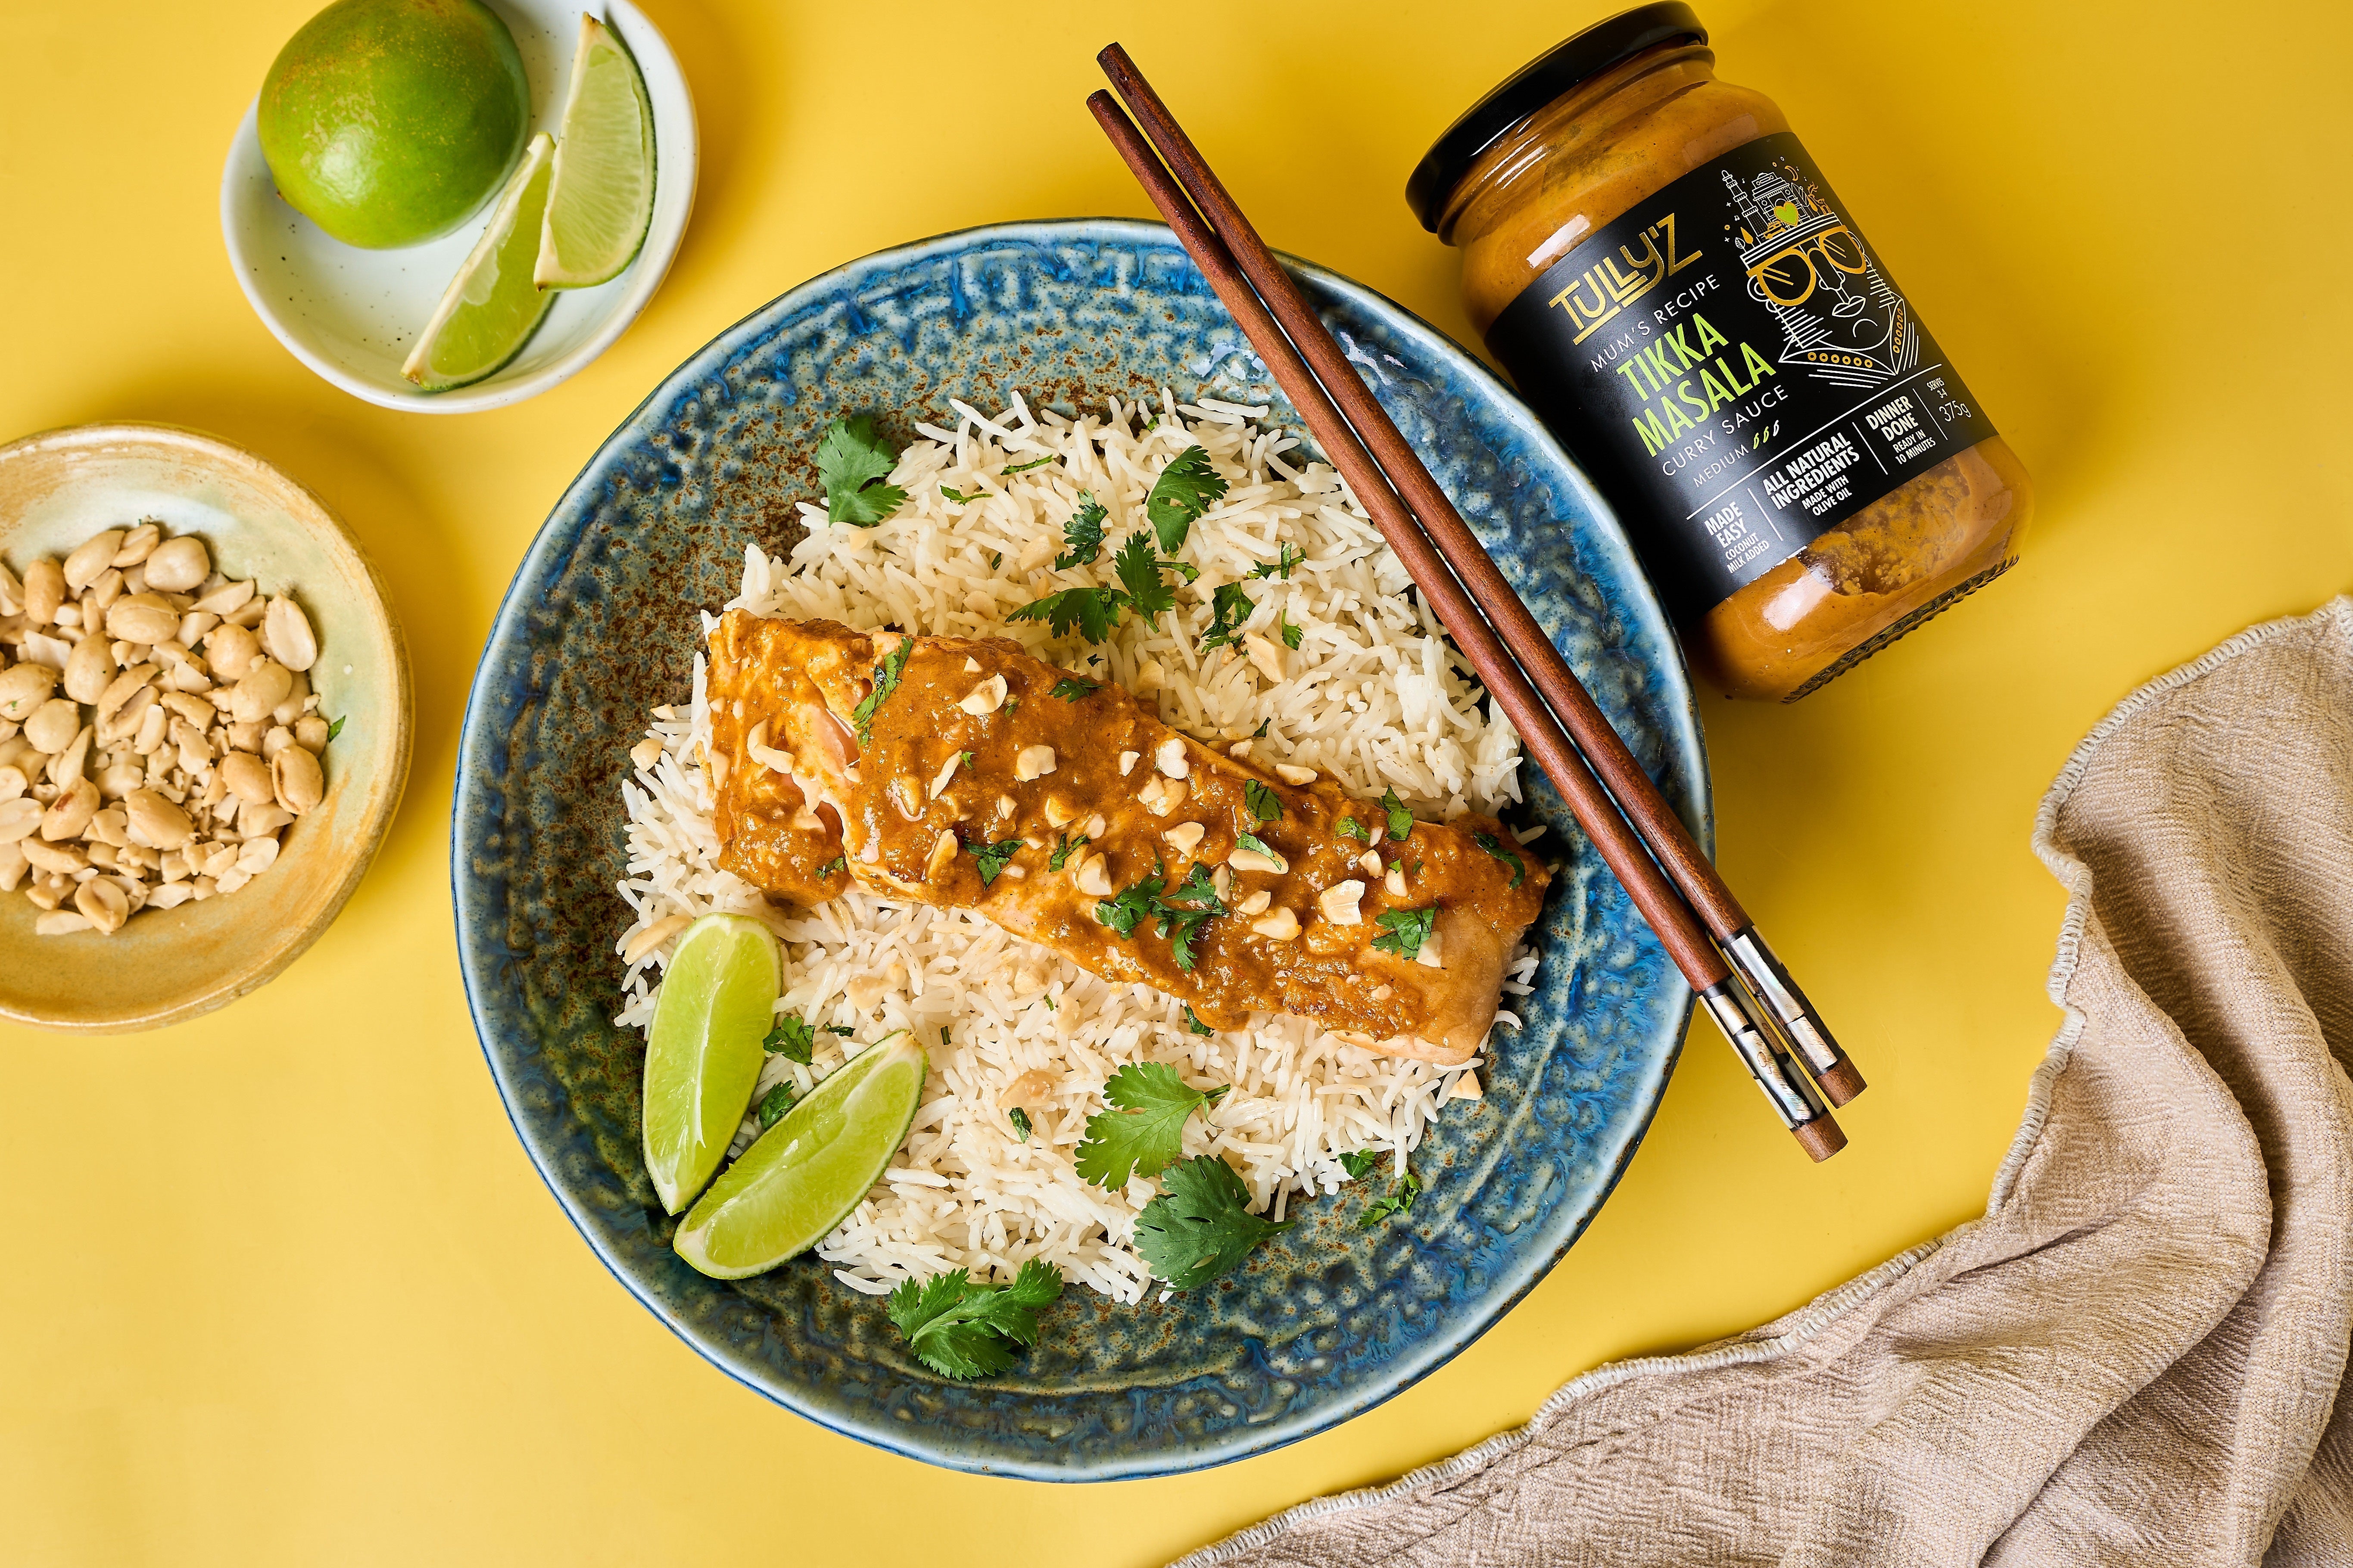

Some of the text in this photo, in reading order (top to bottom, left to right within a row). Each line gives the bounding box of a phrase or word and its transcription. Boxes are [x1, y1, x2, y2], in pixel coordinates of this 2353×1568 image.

[1590, 274, 1720, 373] MUM'S RECIPE
[1616, 313, 1729, 401] TIKKA
[1632, 342, 1776, 457] MASALA
[1926, 377, 1945, 391] SERVES
[1865, 396, 1914, 430] DINNER
[1881, 412, 1918, 442] DONE
[1939, 400, 1971, 422] 375g
[1662, 385, 1788, 476] CURRY SAUCE
[1892, 429, 1926, 453] READY IN
[1693, 444, 1749, 488] MEDIUM
[1762, 432, 1851, 496] ALL NATURAL
[1895, 437, 1936, 464] 10 MINUTES
[1770, 446, 1860, 510] INGREDIENTS
[1801, 475, 1849, 510] MADE WITH
[1704, 501, 1743, 536] MADE
[1812, 488, 1852, 516] OLIVE OIL
[1715, 518, 1748, 548] EASY
[1725, 532, 1759, 560] COCONUT
[1727, 540, 1769, 573] MILK ADDED
